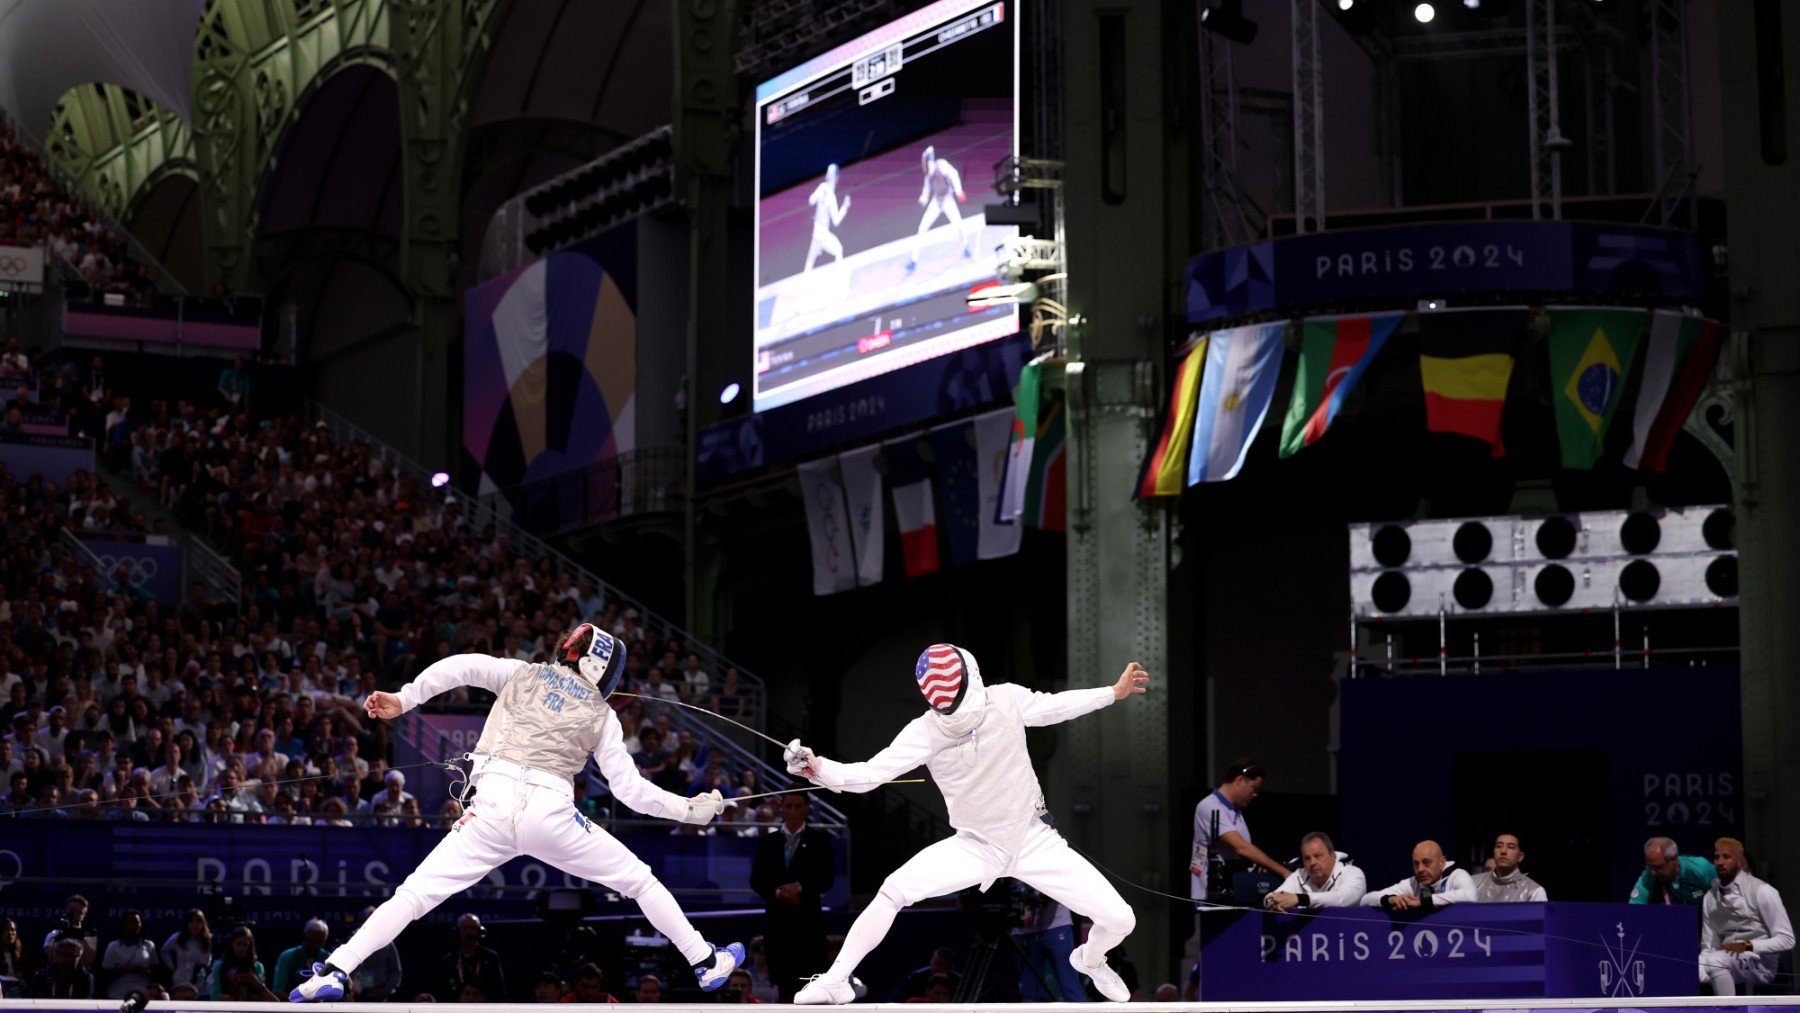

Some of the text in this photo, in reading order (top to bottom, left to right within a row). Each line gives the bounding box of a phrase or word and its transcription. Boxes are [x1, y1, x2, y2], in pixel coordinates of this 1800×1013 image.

[1429, 244, 1523, 270] 2024
[591, 632, 614, 662] FRA
[543, 691, 565, 714] FRA
[1644, 800, 1735, 827] 2024
[1388, 928, 1491, 960] 2024
